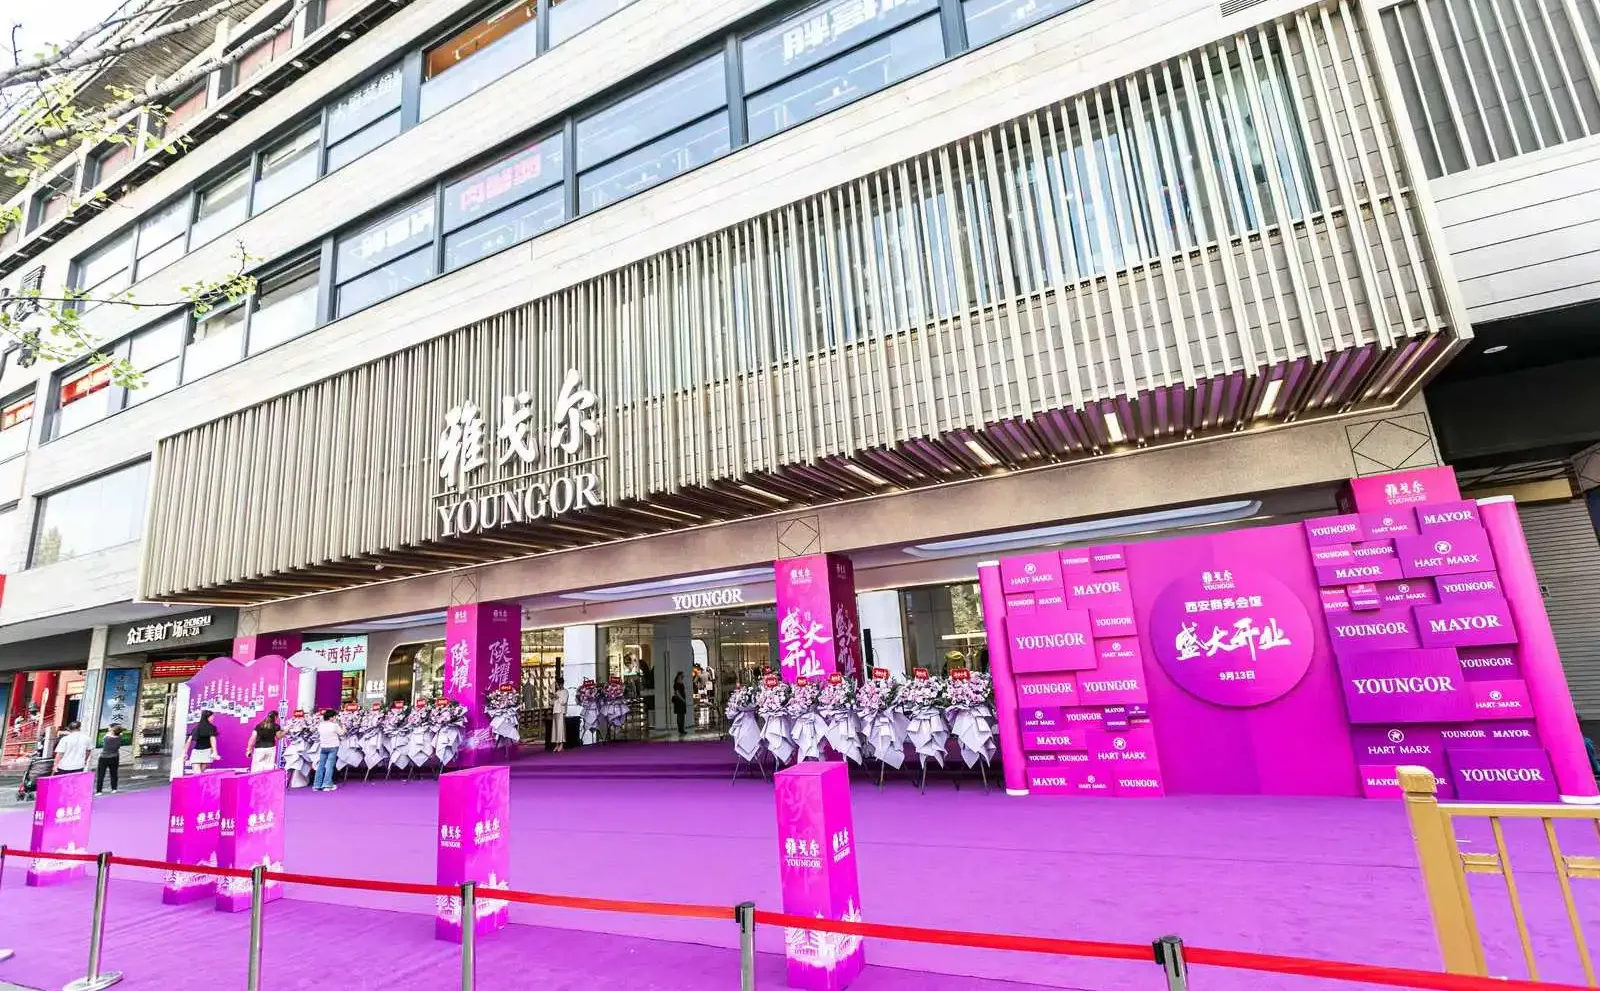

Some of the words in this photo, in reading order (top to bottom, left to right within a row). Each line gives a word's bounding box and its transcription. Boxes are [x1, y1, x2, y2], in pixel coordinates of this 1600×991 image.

[438, 368, 599, 494] 雅戈尔
[437, 473, 604, 537] YOUNGOR
[1424, 510, 1474, 525] MAYOR
[1311, 523, 1357, 537] YOUNGOR
[1371, 526, 1388, 534] HART
[1389, 524, 1409, 532] MARX
[1353, 546, 1394, 557] YOUNGOR
[1414, 557, 1443, 568] HART
[1446, 554, 1480, 566] MARX
[1010, 574, 1031, 585] HART
[1032, 573, 1053, 584] MARX
[1335, 566, 1383, 579] MAYOR
[1073, 581, 1123, 597] MAYOR
[1443, 581, 1496, 594] YOUNGOR
[672, 588, 744, 610] YOUNGOR
[1385, 594, 1404, 602] HART
[1405, 592, 1427, 600] MARX
[1184, 596, 1264, 613] 西安商务会馆
[1096, 616, 1133, 627] YOUNGOR
[1429, 614, 1503, 634] MAYOR
[126, 620, 183, 646] 众汇美食广场
[1336, 621, 1409, 638] YOUNGOR
[1016, 632, 1087, 650] YOUNGOR
[1175, 617, 1292, 661] 盛大开业
[1460, 657, 1514, 668] YOUNGOR
[1219, 670, 1256, 681] 9月13日
[1021, 682, 1074, 695] YOUNGOR
[1083, 679, 1140, 693] YOUNGOR
[1352, 676, 1456, 695] YOUNGOR
[1066, 713, 1103, 722] YOUNGOR
[1441, 730, 1486, 739] YOUNGOR
[1492, 729, 1531, 738] MAYOR
[1036, 736, 1072, 746] MAYOR
[1097, 752, 1119, 760] HART
[1122, 751, 1147, 760] MARX
[1368, 746, 1396, 755] HART
[1400, 745, 1432, 754] MARX
[1058, 754, 1089, 762] YOUNGOR
[1460, 768, 1545, 782] YOUNGOR
[1032, 777, 1067, 787] MAYOR
[1119, 779, 1159, 788] YOUNGOR
[785, 837, 821, 858] 雅戈尔
[785, 858, 823, 868] YOUNGOR
